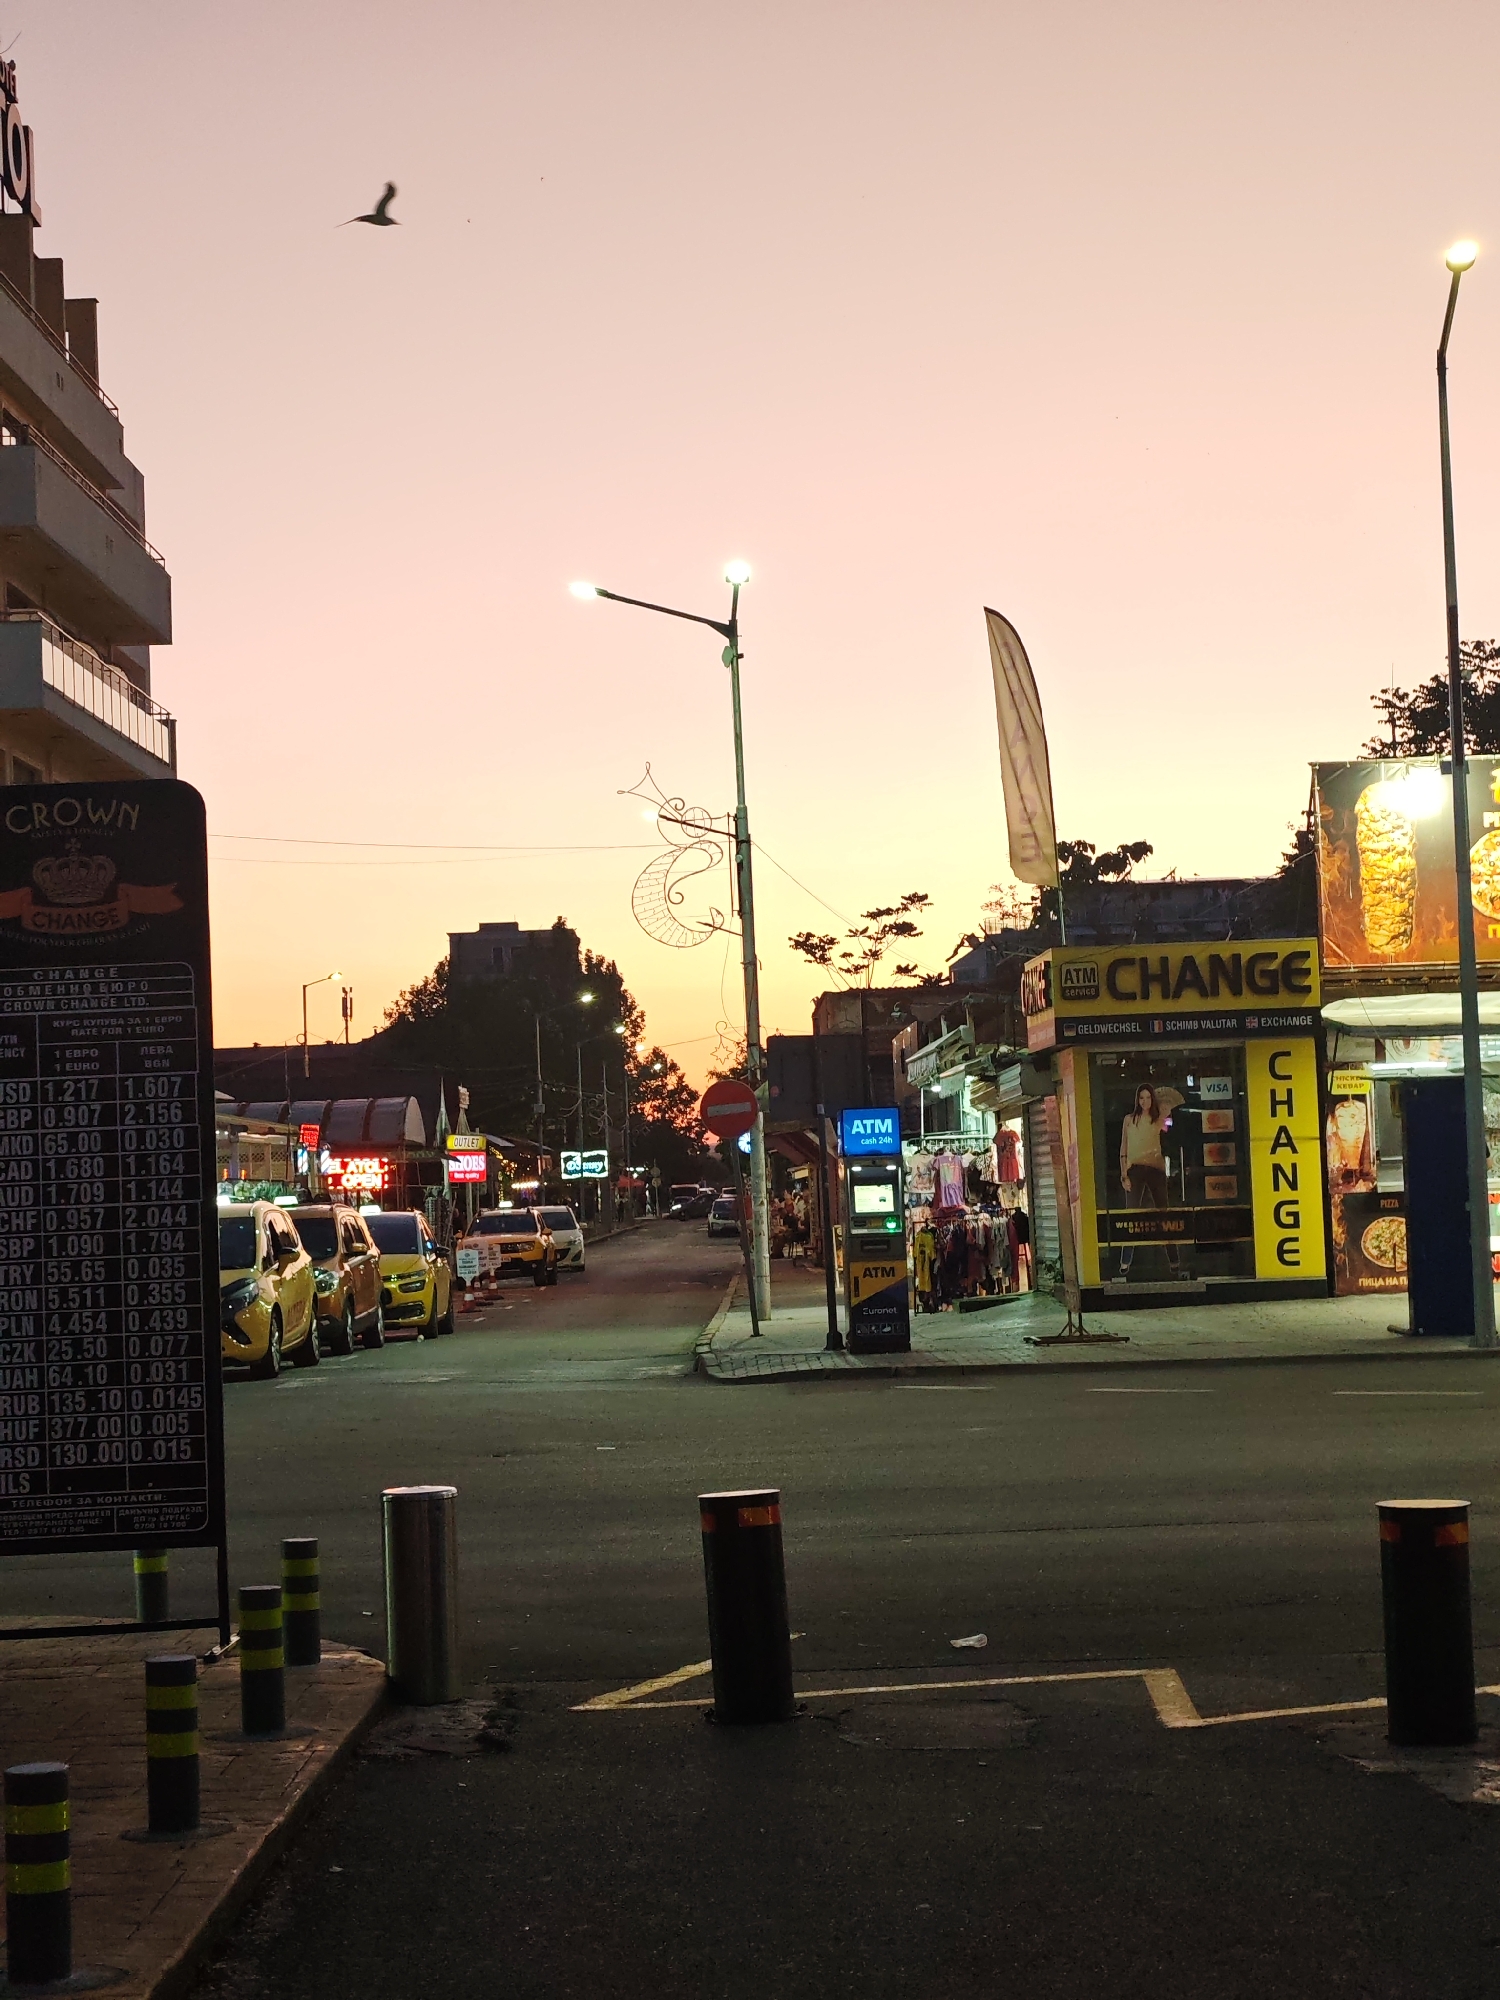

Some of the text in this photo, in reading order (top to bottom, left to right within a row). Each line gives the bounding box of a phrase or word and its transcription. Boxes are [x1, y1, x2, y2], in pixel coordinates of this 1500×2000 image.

[6, 797, 140, 834] CROWN
[31, 908, 119, 929] CHANGE
[33, 968, 119, 980] CHANGE
[1063, 966, 1096, 985] ATM
[1107, 951, 1312, 1000] CHANGE
[3, 981, 149, 997] ОБМЕННО БЮРО
[1065, 986, 1096, 997] service
[3, 996, 150, 1012] CROWN CHANGE LTD.
[53, 1019, 80, 1028] КУРС
[83, 1017, 125, 1027] КУПУВА
[127, 1017, 141, 1025] ЗА
[154, 1015, 183, 1024] ЕВРО
[1078, 1022, 1142, 1035] GELDWECHSEL
[1166, 1018, 1238, 1031] SCHIMB VALUTAR
[1261, 1015, 1313, 1027] EXCHANGE
[71, 1027, 98, 1037] RATE
[101, 1026, 123, 1036] FOR
[135, 1025, 165, 1034] EURO
[0, 1047, 26, 1058] ENCY
[54, 1048, 99, 1059] 1 ЕВРО
[140, 1045, 173, 1056] ЛЕВА
[54, 1062, 100, 1071] 1 EURO
[144, 1059, 170, 1069] BGN
[44, 1078, 100, 1102] 1.217
[124, 1076, 182, 1099] 1.607
[1206, 1083, 1229, 1093] VISA
[44, 1105, 102, 1128] 0.907
[124, 1102, 183, 1125] 2.156
[851, 1118, 893, 1135] ATM
[44, 1131, 101, 1155] 65.00
[124, 1128, 185, 1150] 0.030
[454, 1137, 480, 1147] OUTLET
[45, 1157, 105, 1180] 1.680
[125, 1153, 185, 1176] 1.164
[449, 1155, 484, 1171] SHOES
[1268, 1050, 1301, 1267] CHANGE
[341, 1174, 382, 1187] OPEN
[46, 1182, 105, 1204] 1.709
[126, 1178, 184, 1200] 1.144
[1380, 1199, 1399, 1209] PIZZA
[0, 1205, 188, 1233] CHF 0.957 2.044
[48, 1234, 104, 1257] 1.090
[125, 1230, 185, 1253] 1.794
[0, 1256, 185, 1285] TRY 55.65 0.035
[863, 1266, 896, 1278] ATM
[1359, 1277, 1385, 1288] ПИЦА
[1386, 1277, 1399, 1286] НА
[0, 1282, 186, 1311] RON 5.511 0.355
[863, 1305, 897, 1315] Euronet
[0, 1308, 188, 1337] PLN 4.454 0.439
[0, 1335, 189, 1364] CZK 25.50 0.077
[0, 1361, 189, 1390] UAH 64.10 0.031
[0, 1387, 202, 1416] RUB 135.10 0.0145
[0, 1413, 189, 1441] HUF 377.00 0.005
[0, 1438, 192, 1468] RSD 130.00 0.015
[0, 1473, 30, 1494] ILS
[12, 1497, 72, 1508] ТЕЛЕФОН
[77, 1496, 93, 1505] ЗА
